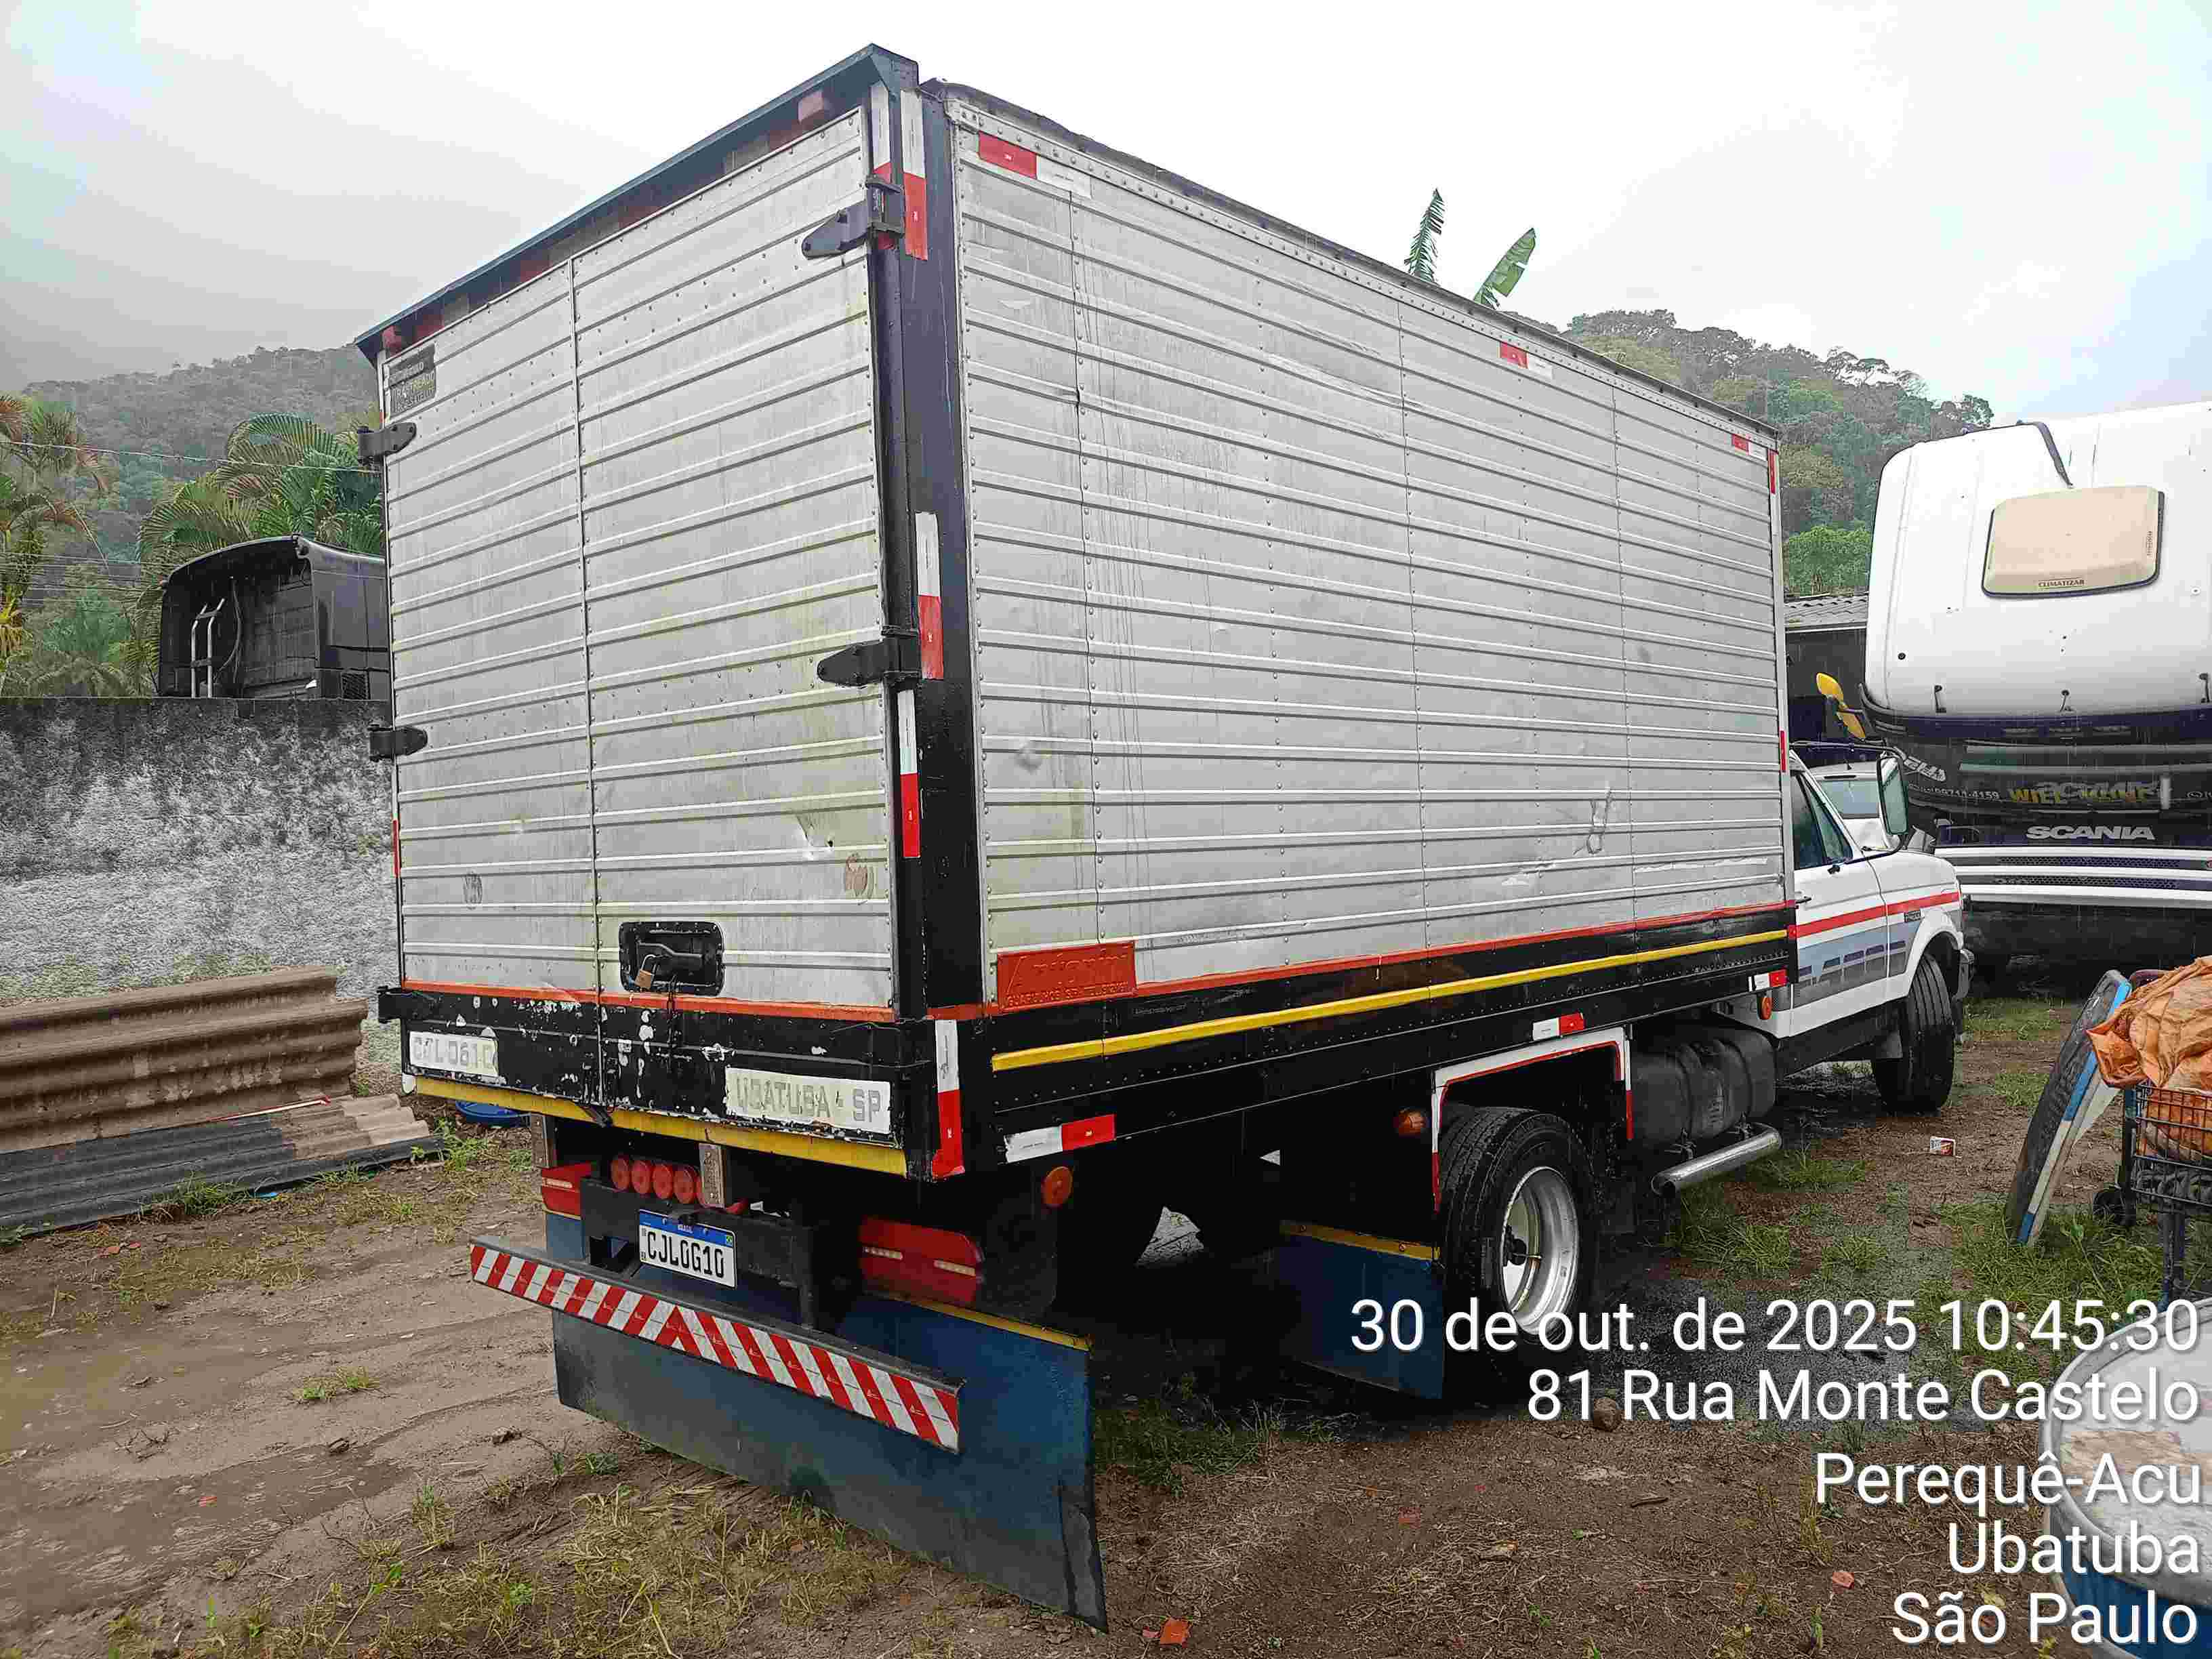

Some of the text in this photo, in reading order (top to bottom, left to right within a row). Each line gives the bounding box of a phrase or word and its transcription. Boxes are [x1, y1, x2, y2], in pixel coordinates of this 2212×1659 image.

[2026, 825, 2156, 841] SCANIA
[736, 1076, 832, 1118] UBATUBA
[852, 1088, 882, 1123] SP
